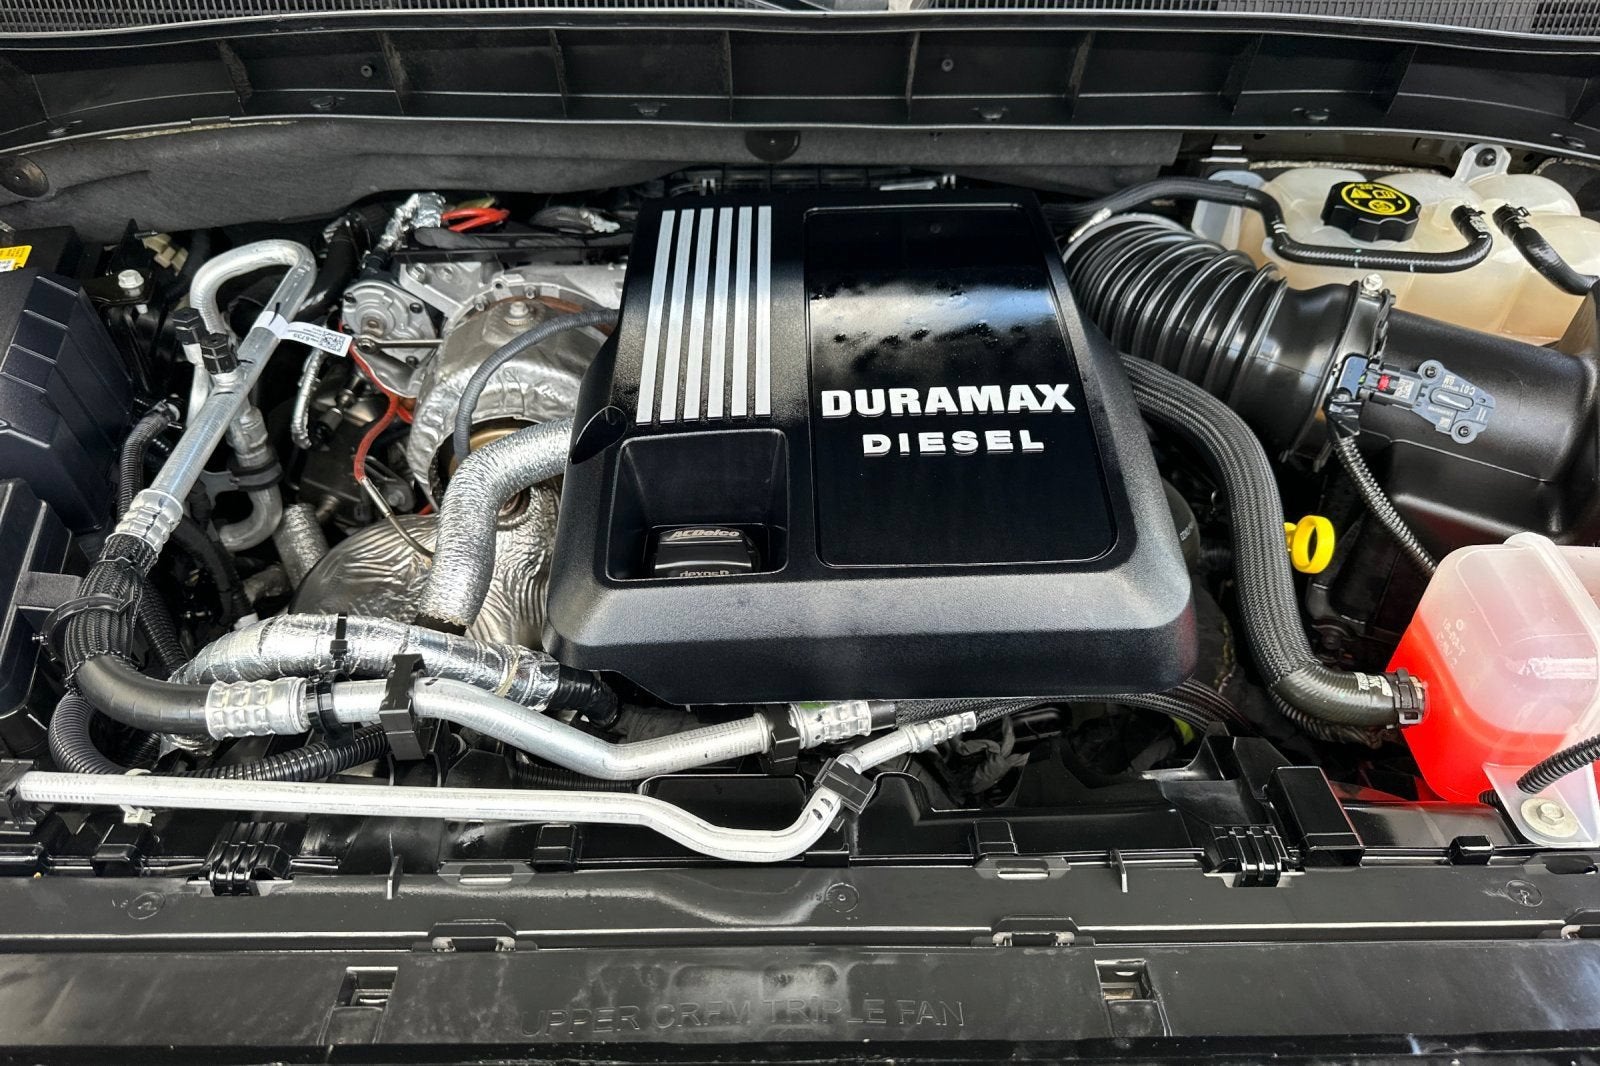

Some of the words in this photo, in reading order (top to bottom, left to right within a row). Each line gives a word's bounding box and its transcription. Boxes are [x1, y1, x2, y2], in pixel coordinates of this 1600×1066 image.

[821, 383, 1076, 418] DURAMAX
[862, 429, 1045, 457] DIESEL
[669, 529, 740, 540] ACDelco
[521, 1005, 640, 1037] UPPER
[762, 999, 886, 1024] TRIPLE
[896, 999, 964, 1026] FAN
